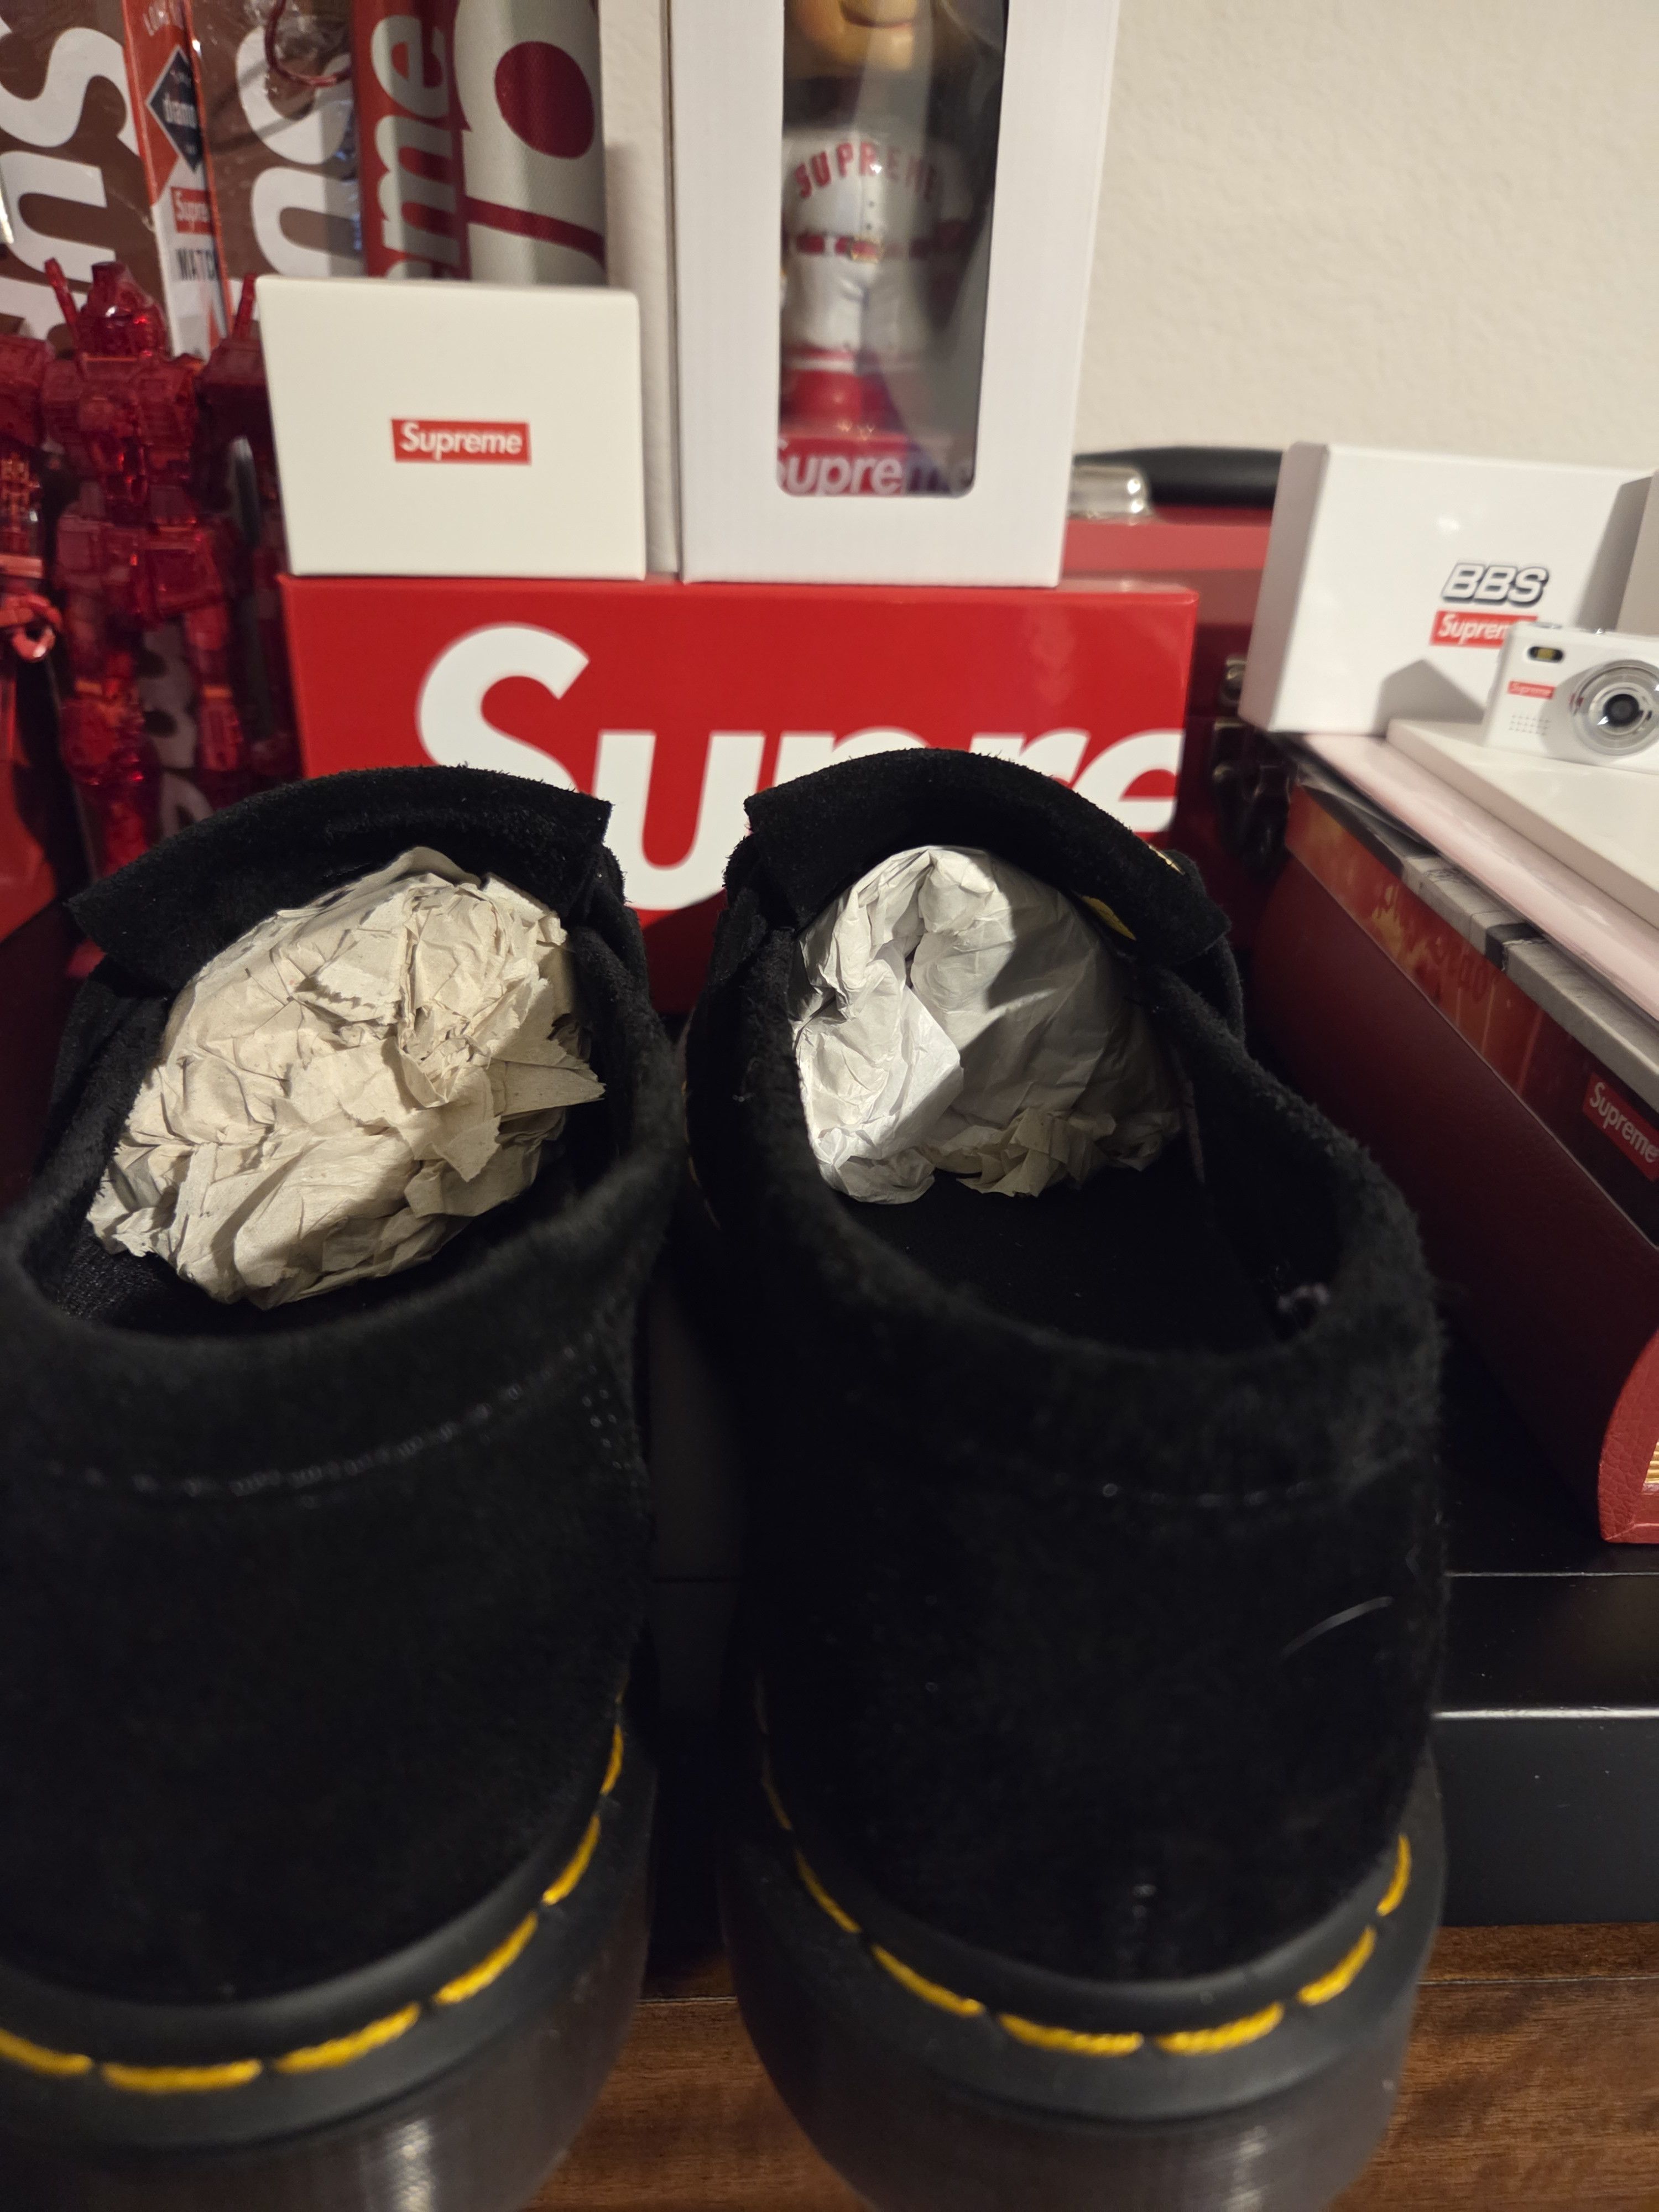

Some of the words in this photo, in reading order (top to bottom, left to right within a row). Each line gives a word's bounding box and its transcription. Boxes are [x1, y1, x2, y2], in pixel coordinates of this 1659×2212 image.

[400, 420, 524, 461] Supreme
[1441, 561, 1550, 607] BBS
[1589, 1082, 1659, 1163] Supreme
